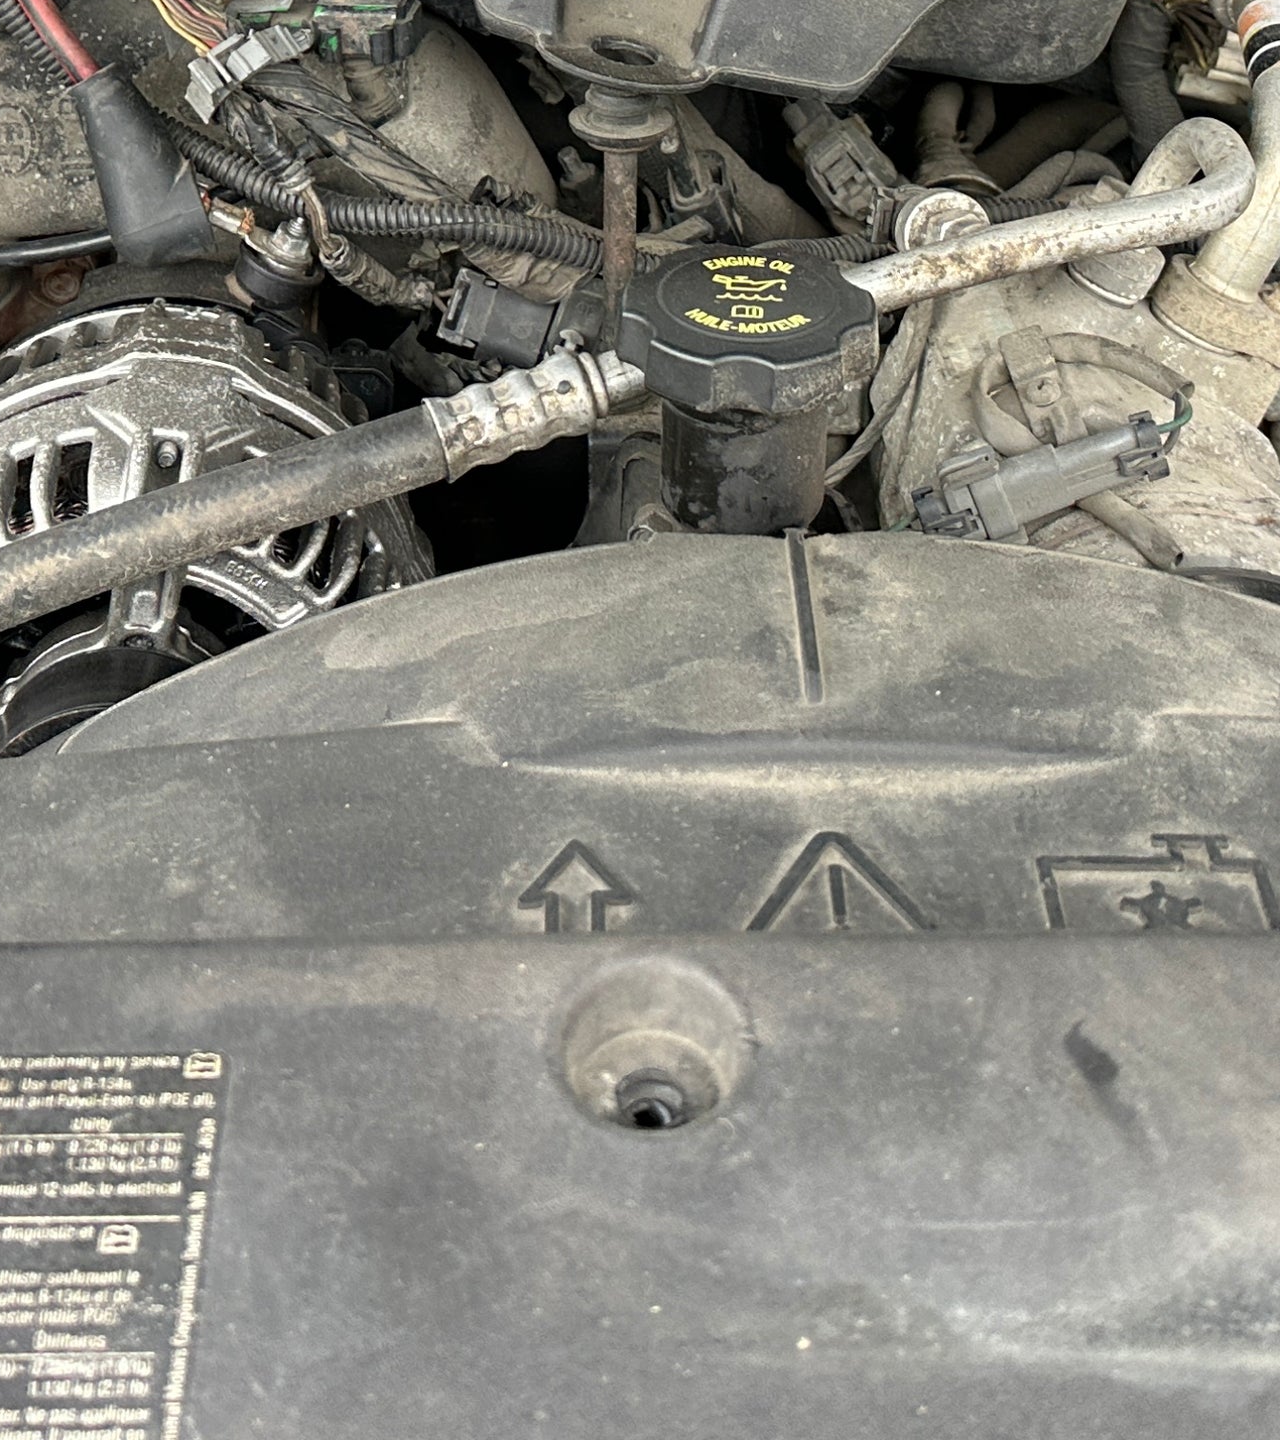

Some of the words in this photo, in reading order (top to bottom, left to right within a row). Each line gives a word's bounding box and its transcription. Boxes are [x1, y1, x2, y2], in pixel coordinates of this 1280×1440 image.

[702, 256, 767, 271] ENGINE
[769, 259, 795, 275] OIL
[684, 308, 812, 334] HUILE-MOTEUR
